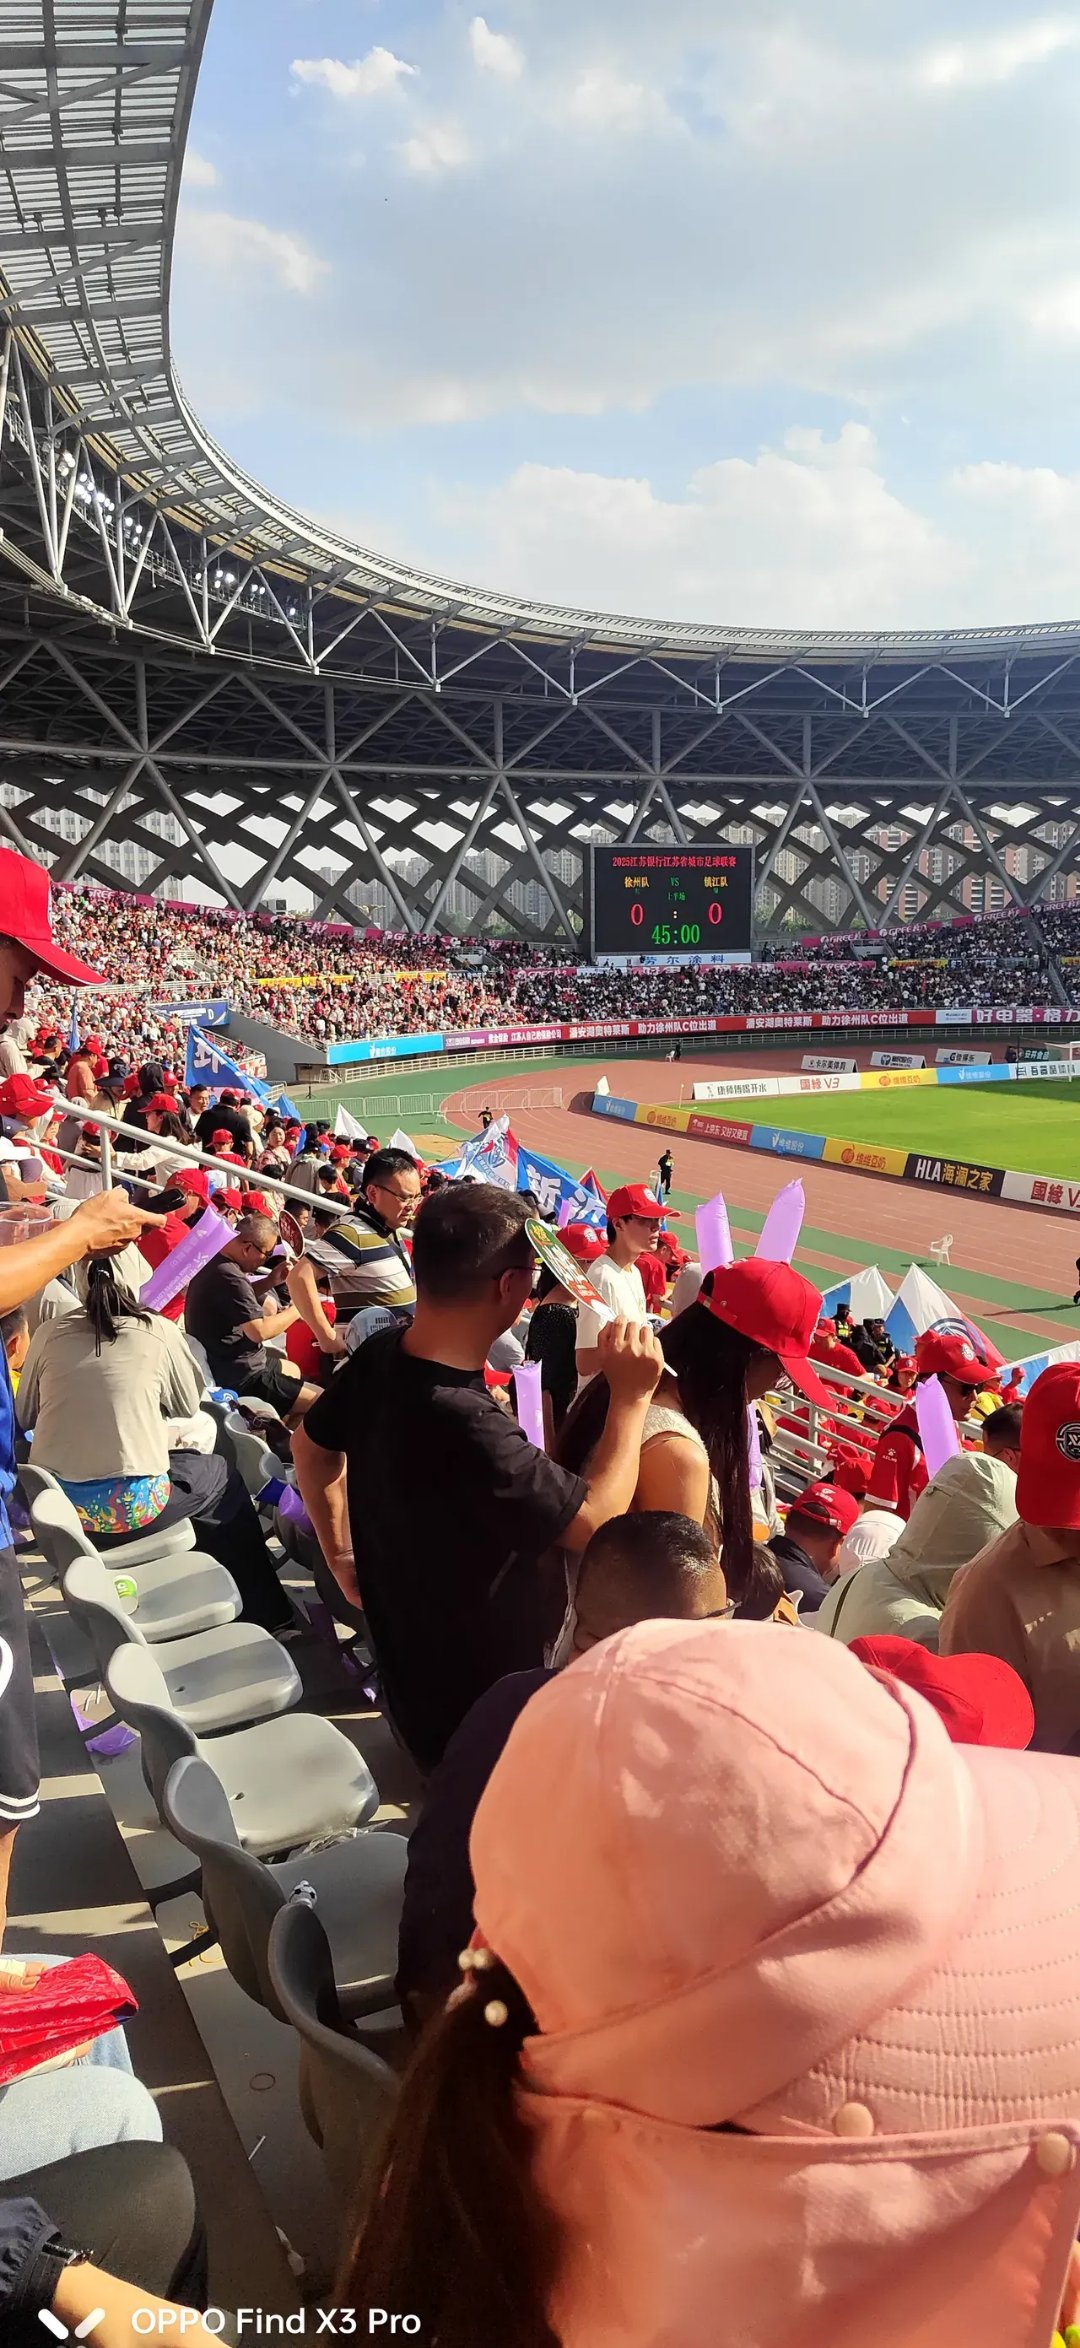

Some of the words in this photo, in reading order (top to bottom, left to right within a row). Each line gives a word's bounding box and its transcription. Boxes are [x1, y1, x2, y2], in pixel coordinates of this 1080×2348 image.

[612, 856, 737, 868] 2025江苏银行江苏省城市足球联赛
[624, 876, 650, 888] 徐州队
[670, 877, 680, 887] VS
[703, 876, 728, 888] 镇江队
[630, 903, 644, 926] 0
[708, 902, 722, 925] 0
[652, 924, 700, 945] 45:00
[637, 1019, 717, 1035] 助力徐州队C位出道
[746, 1016, 813, 1030] 潘安湖奥特莱斯
[821, 1012, 909, 1026] 助力徐州队C位出道
[823, 1077, 840, 1089] V3
[854, 1152, 887, 1171] 维维豆奶
[915, 1158, 941, 1183] HLA
[941, 1162, 993, 1192] 海澜之家
